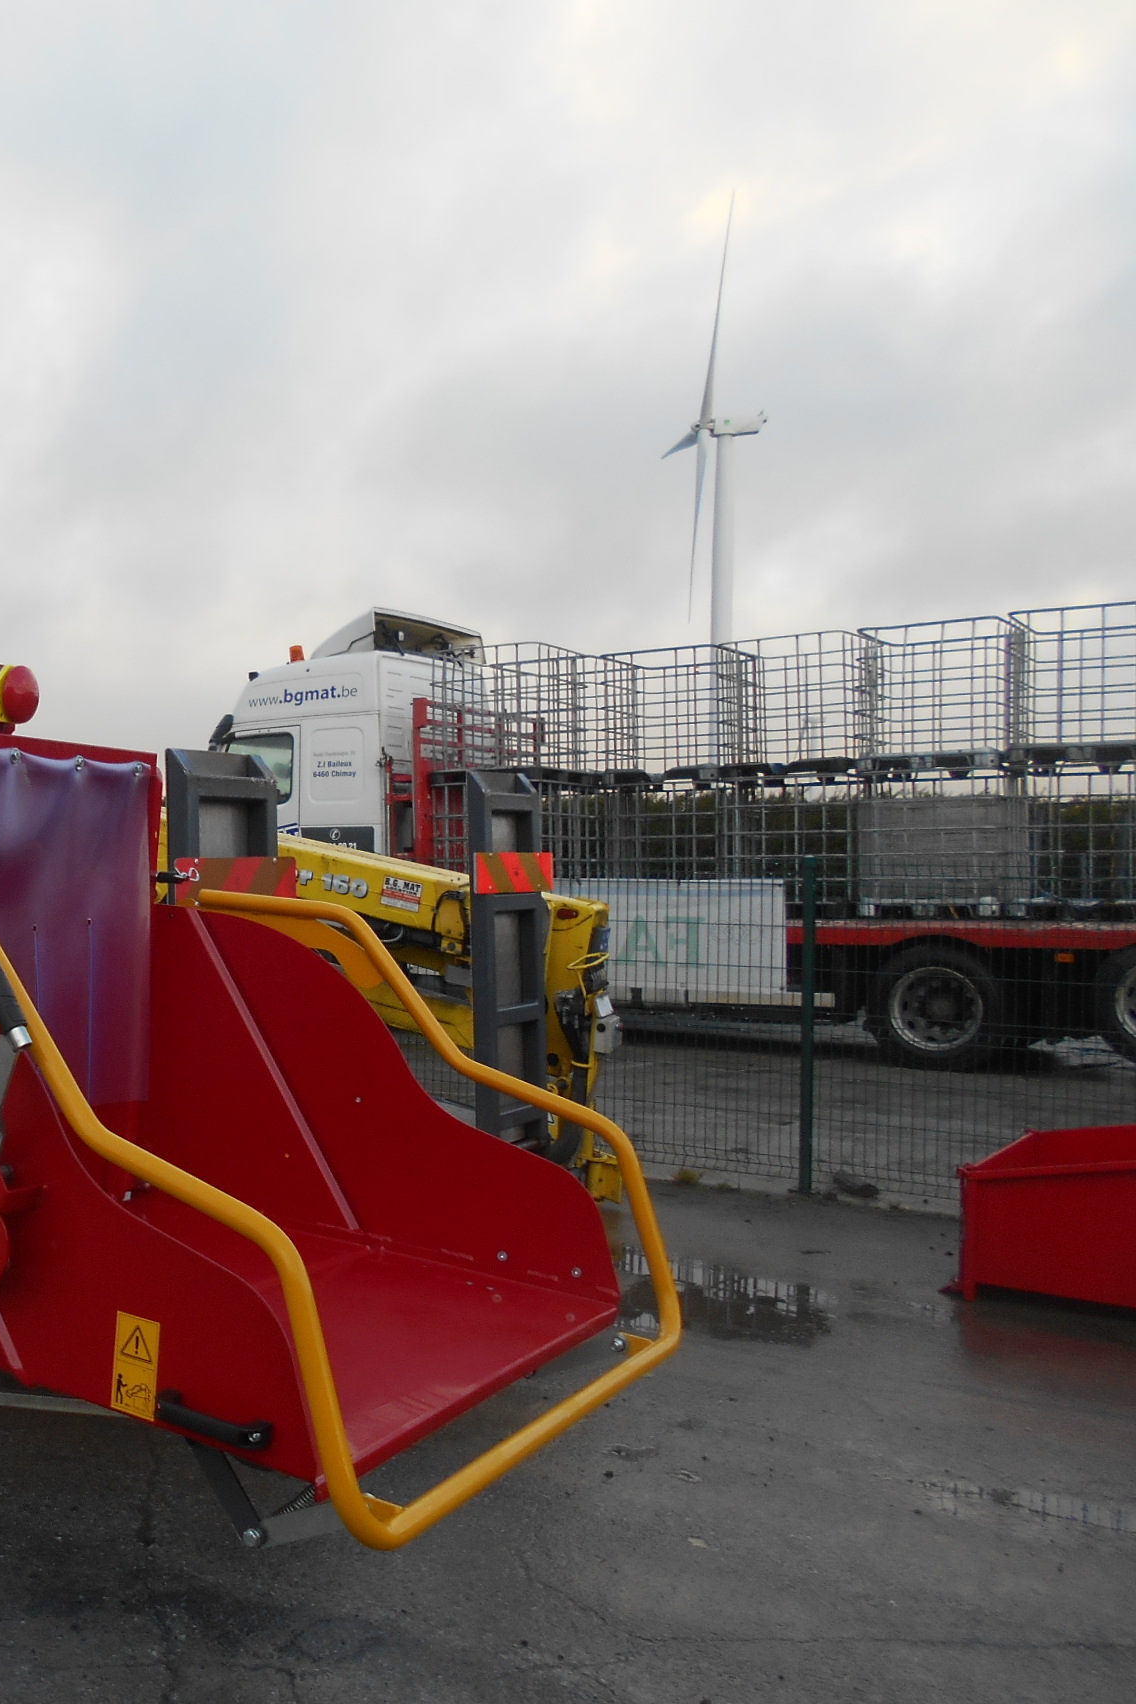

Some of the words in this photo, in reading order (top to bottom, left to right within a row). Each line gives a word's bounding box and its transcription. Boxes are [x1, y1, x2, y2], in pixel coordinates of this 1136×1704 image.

[248, 686, 358, 707] www.bgmat.be
[331, 770, 357, 778] Chimay
[322, 873, 368, 898] 160
[402, 881, 421, 893] MAT
